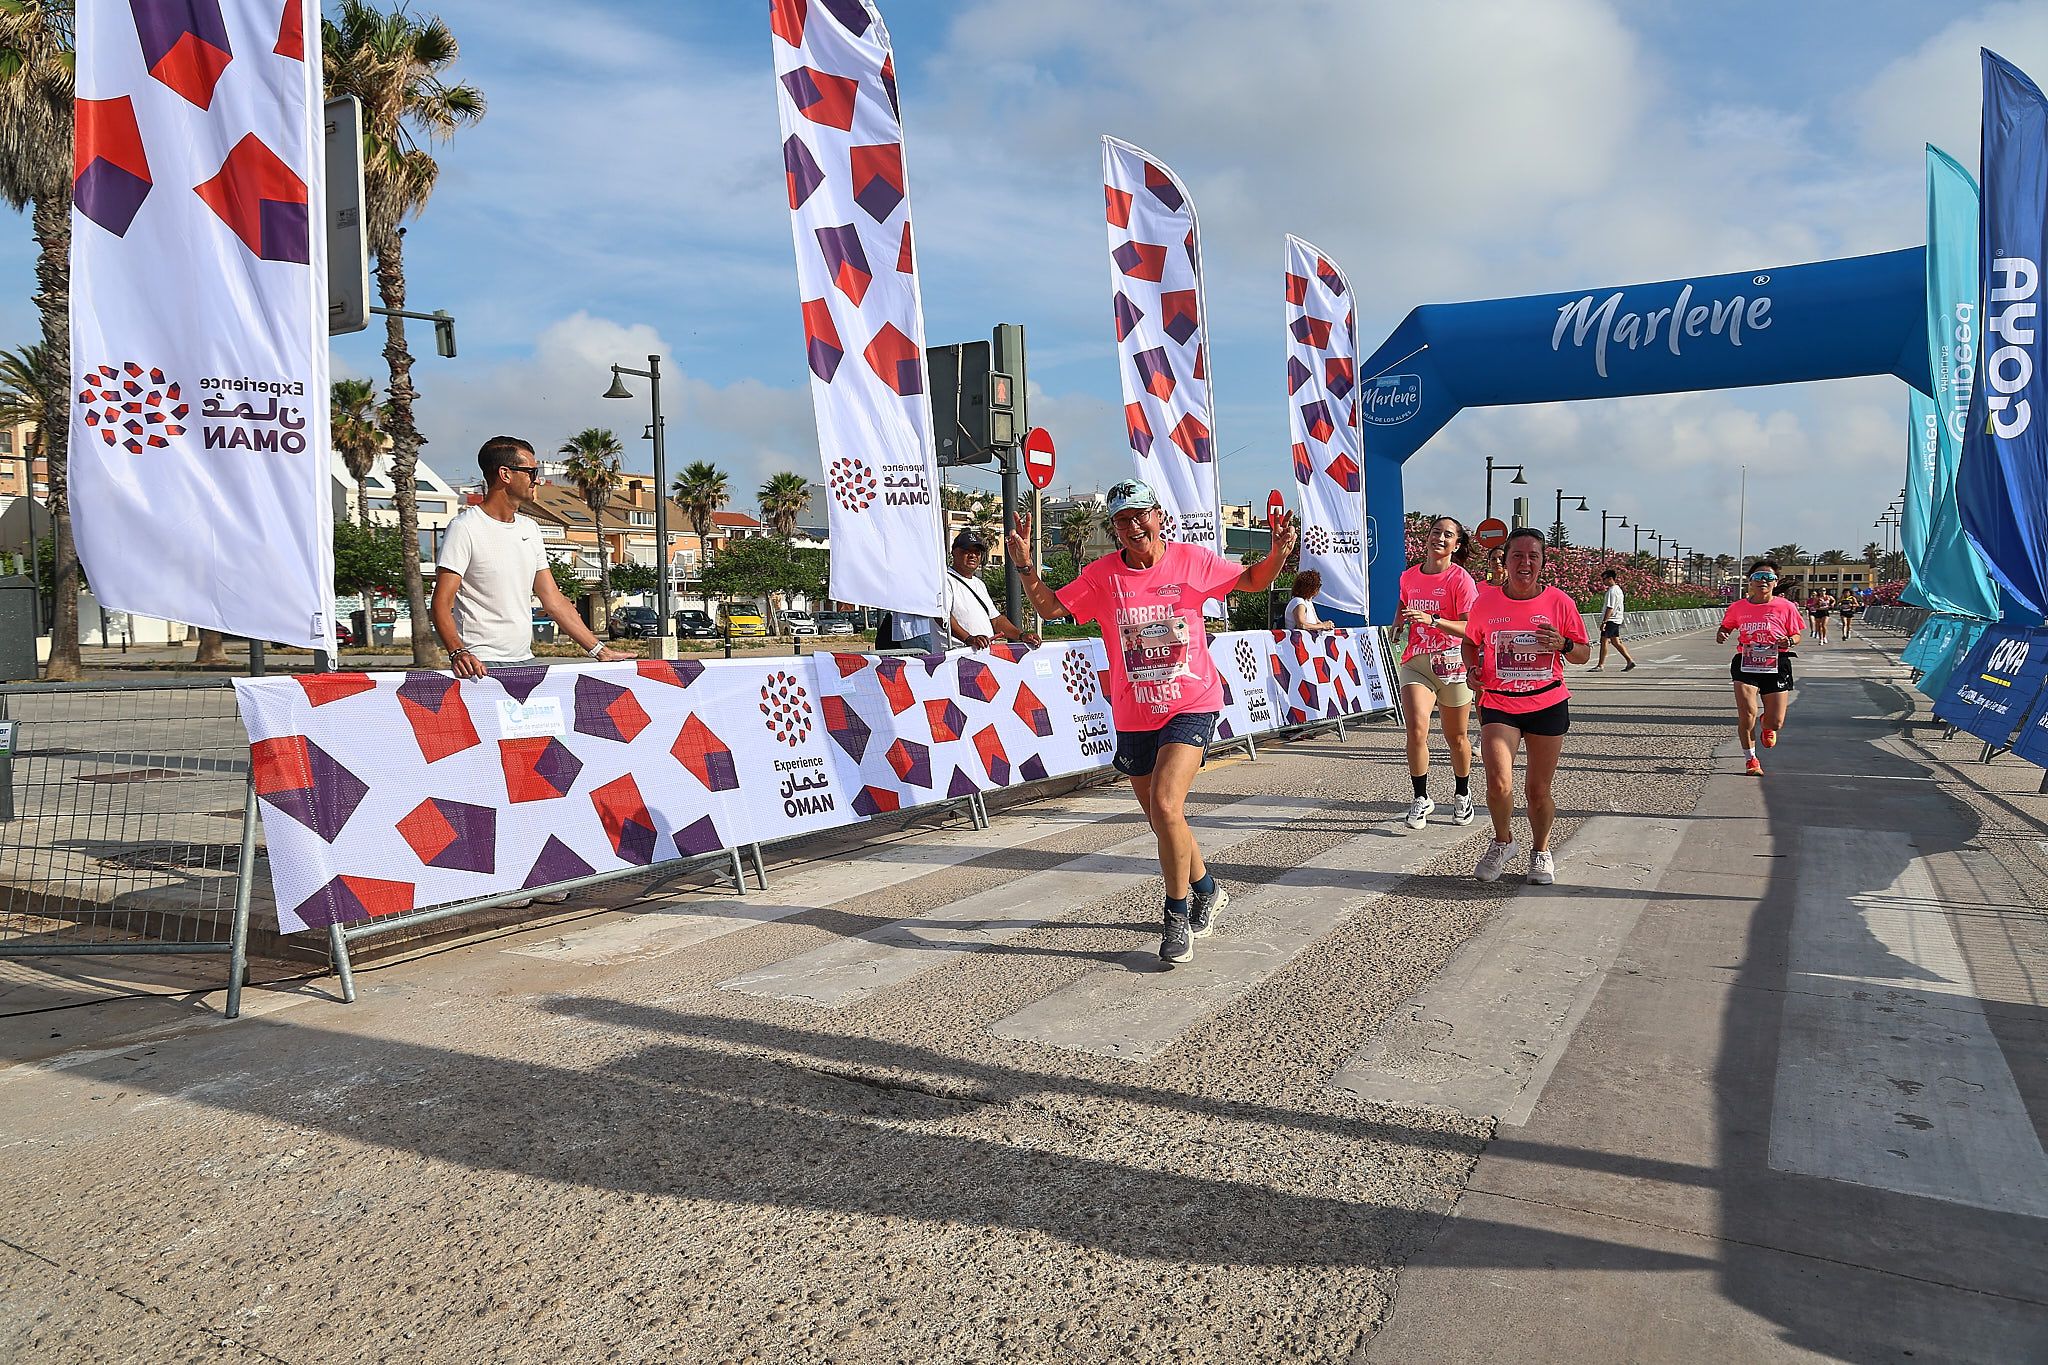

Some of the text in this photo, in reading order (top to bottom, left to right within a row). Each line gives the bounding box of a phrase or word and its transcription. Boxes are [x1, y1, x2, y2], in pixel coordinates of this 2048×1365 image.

[1552, 284, 1772, 378] Marlene
[1361, 387, 1416, 412] Marlene
[1396, 410, 1412, 421] ALPES
[1116, 603, 1176, 626] CARRERA
[1145, 646, 1171, 659] 016
[1514, 653, 1537, 662] 016
[1987, 638, 2030, 676] GOYA
[1133, 671, 1155, 680] YSHO
[1135, 682, 1182, 704] MUJER
[1073, 712, 1104, 723] Experience
[1250, 709, 1271, 723] OMAN
[1081, 738, 1113, 757] OMAN
[774, 757, 823, 772] Experience
[784, 793, 835, 818] OMAN
